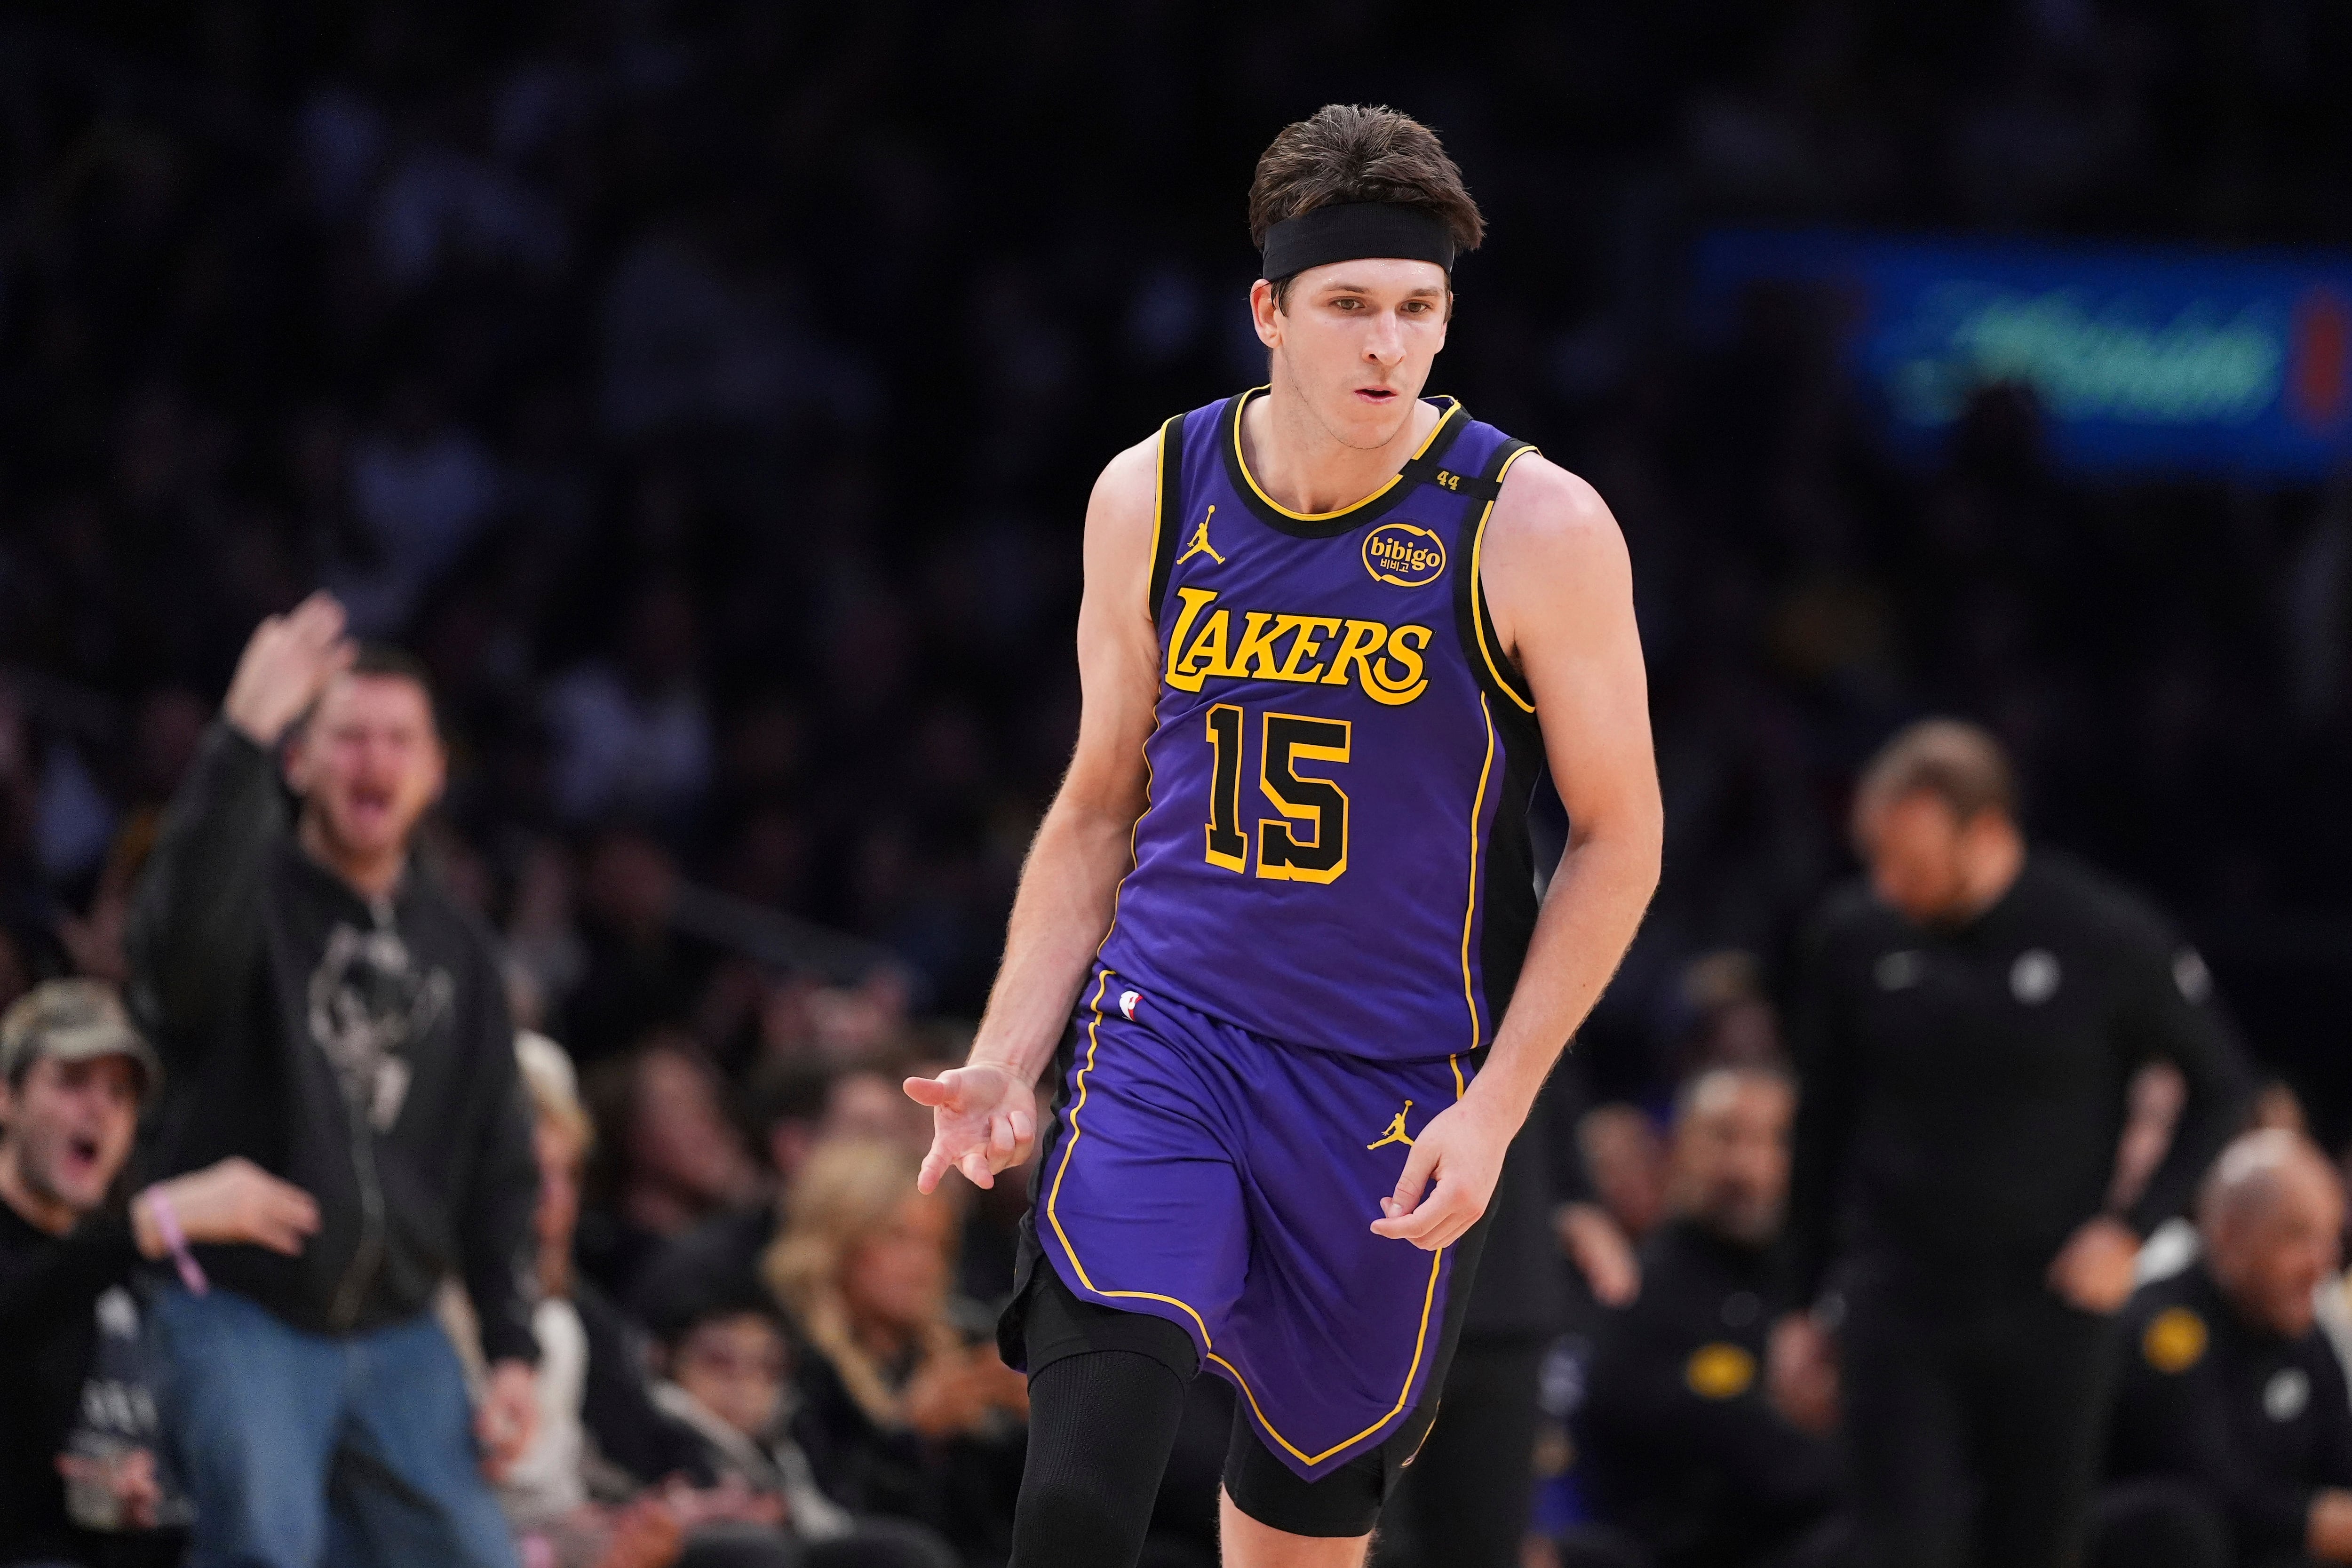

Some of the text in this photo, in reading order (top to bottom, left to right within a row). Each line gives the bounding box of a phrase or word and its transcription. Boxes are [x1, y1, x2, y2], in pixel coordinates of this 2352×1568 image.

[1437, 470, 1460, 491] 44
[1370, 536, 1441, 571] bibigo
[1380, 558, 1409, 573] 비비고
[1165, 586, 1434, 706] LAKERS
[1204, 703, 1352, 885] 15
